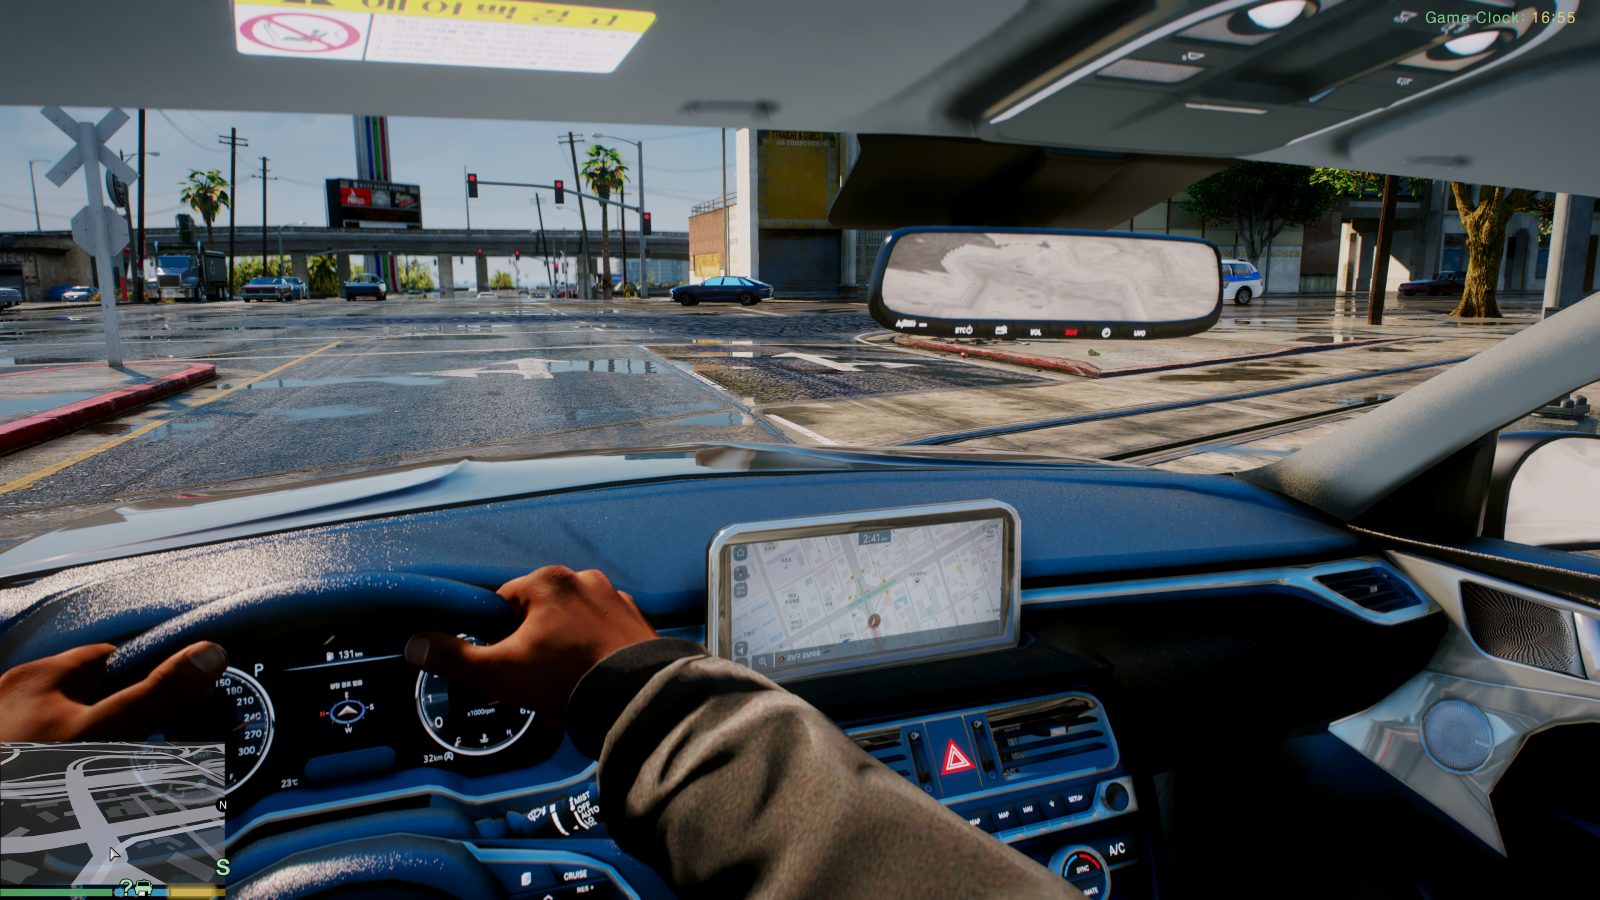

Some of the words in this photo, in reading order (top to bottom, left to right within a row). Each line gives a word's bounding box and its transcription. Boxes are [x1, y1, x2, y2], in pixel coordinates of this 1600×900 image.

[772, 130, 797, 140] STRAIGHT
[803, 131, 821, 141] DIRECT
[862, 533, 881, 544] 2:41
[254, 663, 264, 677] P
[215, 678, 231, 688] 150
[226, 686, 243, 695] 180
[236, 696, 254, 706] 210
[427, 694, 432, 703] 1
[244, 712, 261, 722] 240
[434, 716, 443, 728] 0
[244, 729, 262, 740] 270
[344, 726, 353, 734] W
[238, 745, 255, 756] 300
[574, 790, 590, 805] MIST
[577, 801, 591, 813] OFF
[581, 805, 600, 819] AUTO
[998, 811, 1009, 819] MAP
[1109, 842, 1126, 857] A/C
[563, 869, 587, 881] CRUISE
[1076, 865, 1090, 874] SYNC
